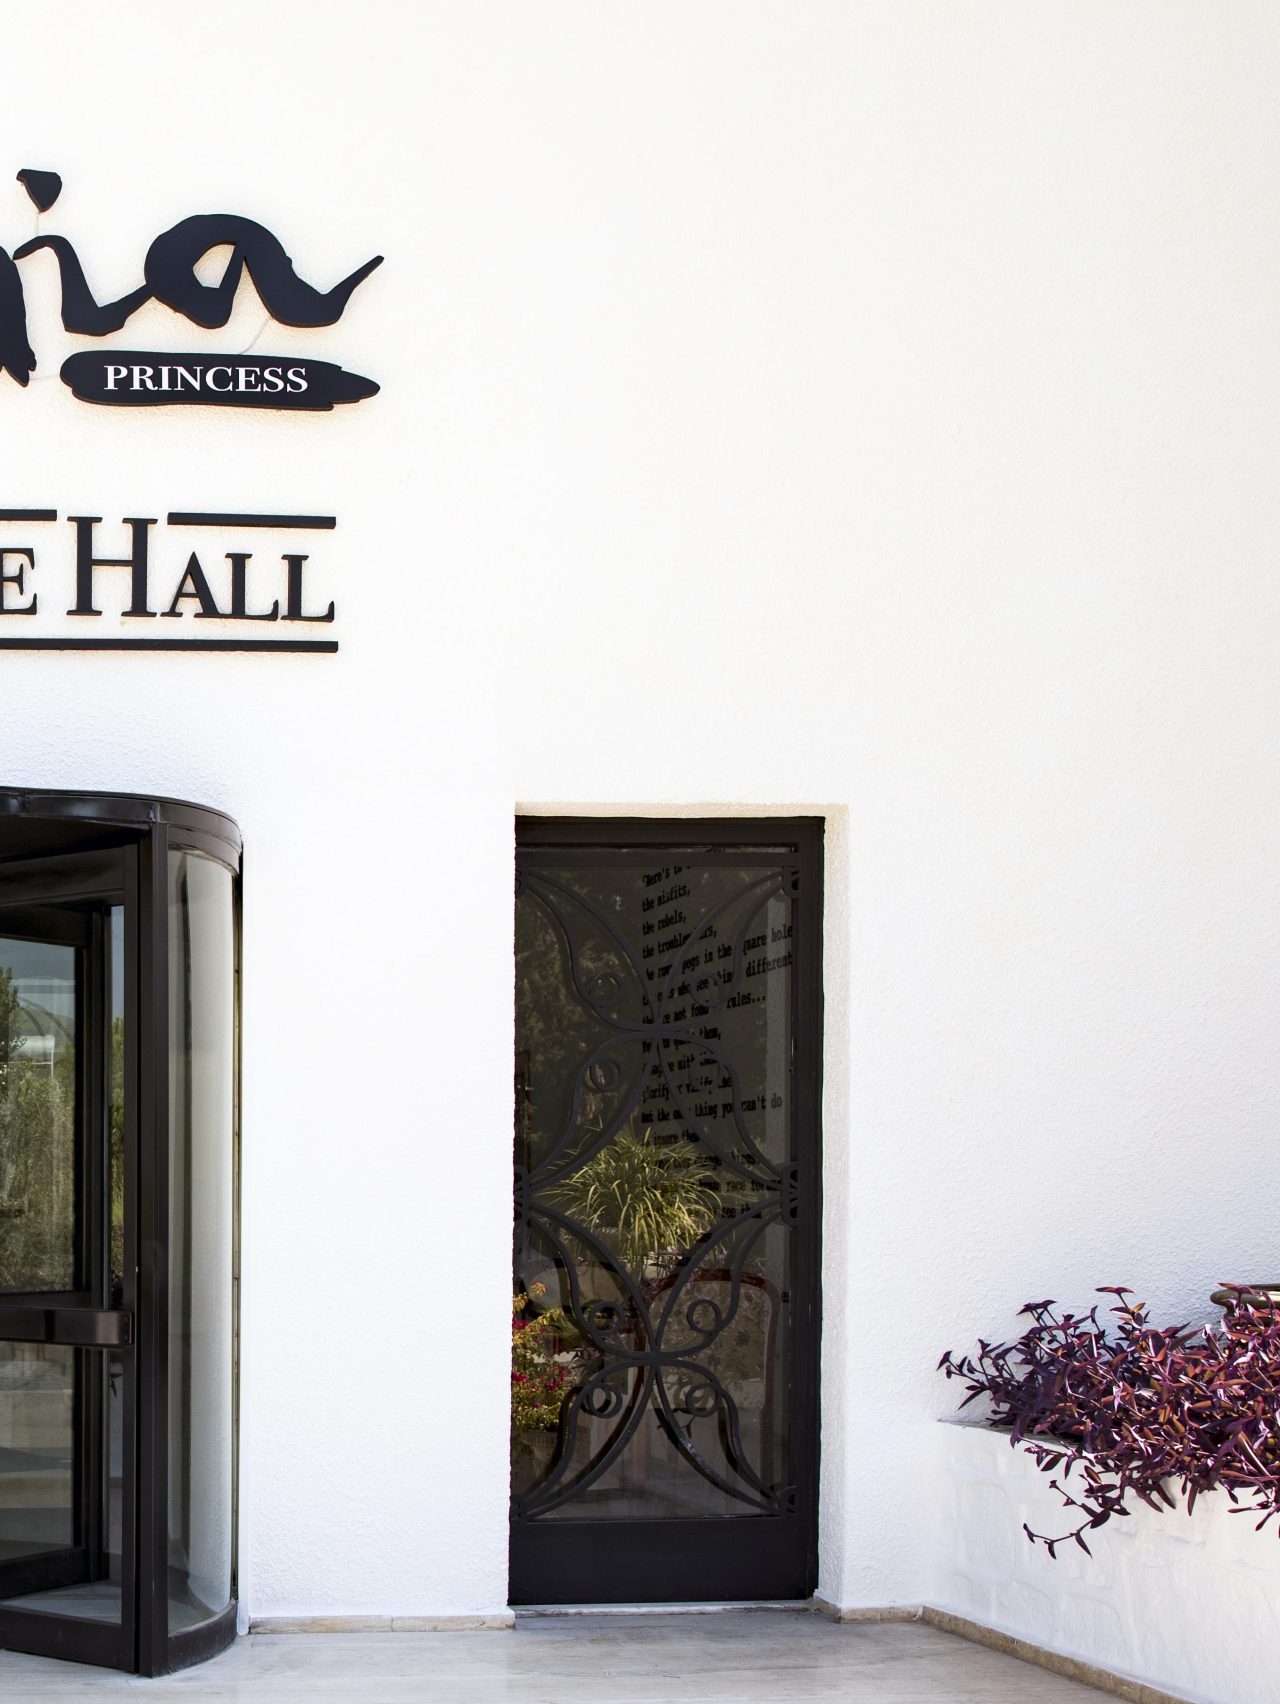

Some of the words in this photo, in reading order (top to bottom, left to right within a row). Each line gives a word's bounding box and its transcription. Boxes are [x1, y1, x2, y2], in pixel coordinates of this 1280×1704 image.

[103, 364, 309, 393] PRINCESS
[66, 516, 335, 622] HALL
[642, 897, 654, 912] the
[642, 921, 654, 935] the
[642, 945, 654, 959] the
[704, 949, 714, 963] in
[718, 944, 732, 959] the
[695, 1101, 718, 1119] thing
[741, 1096, 767, 1112] can't
[771, 1093, 783, 1109] do
